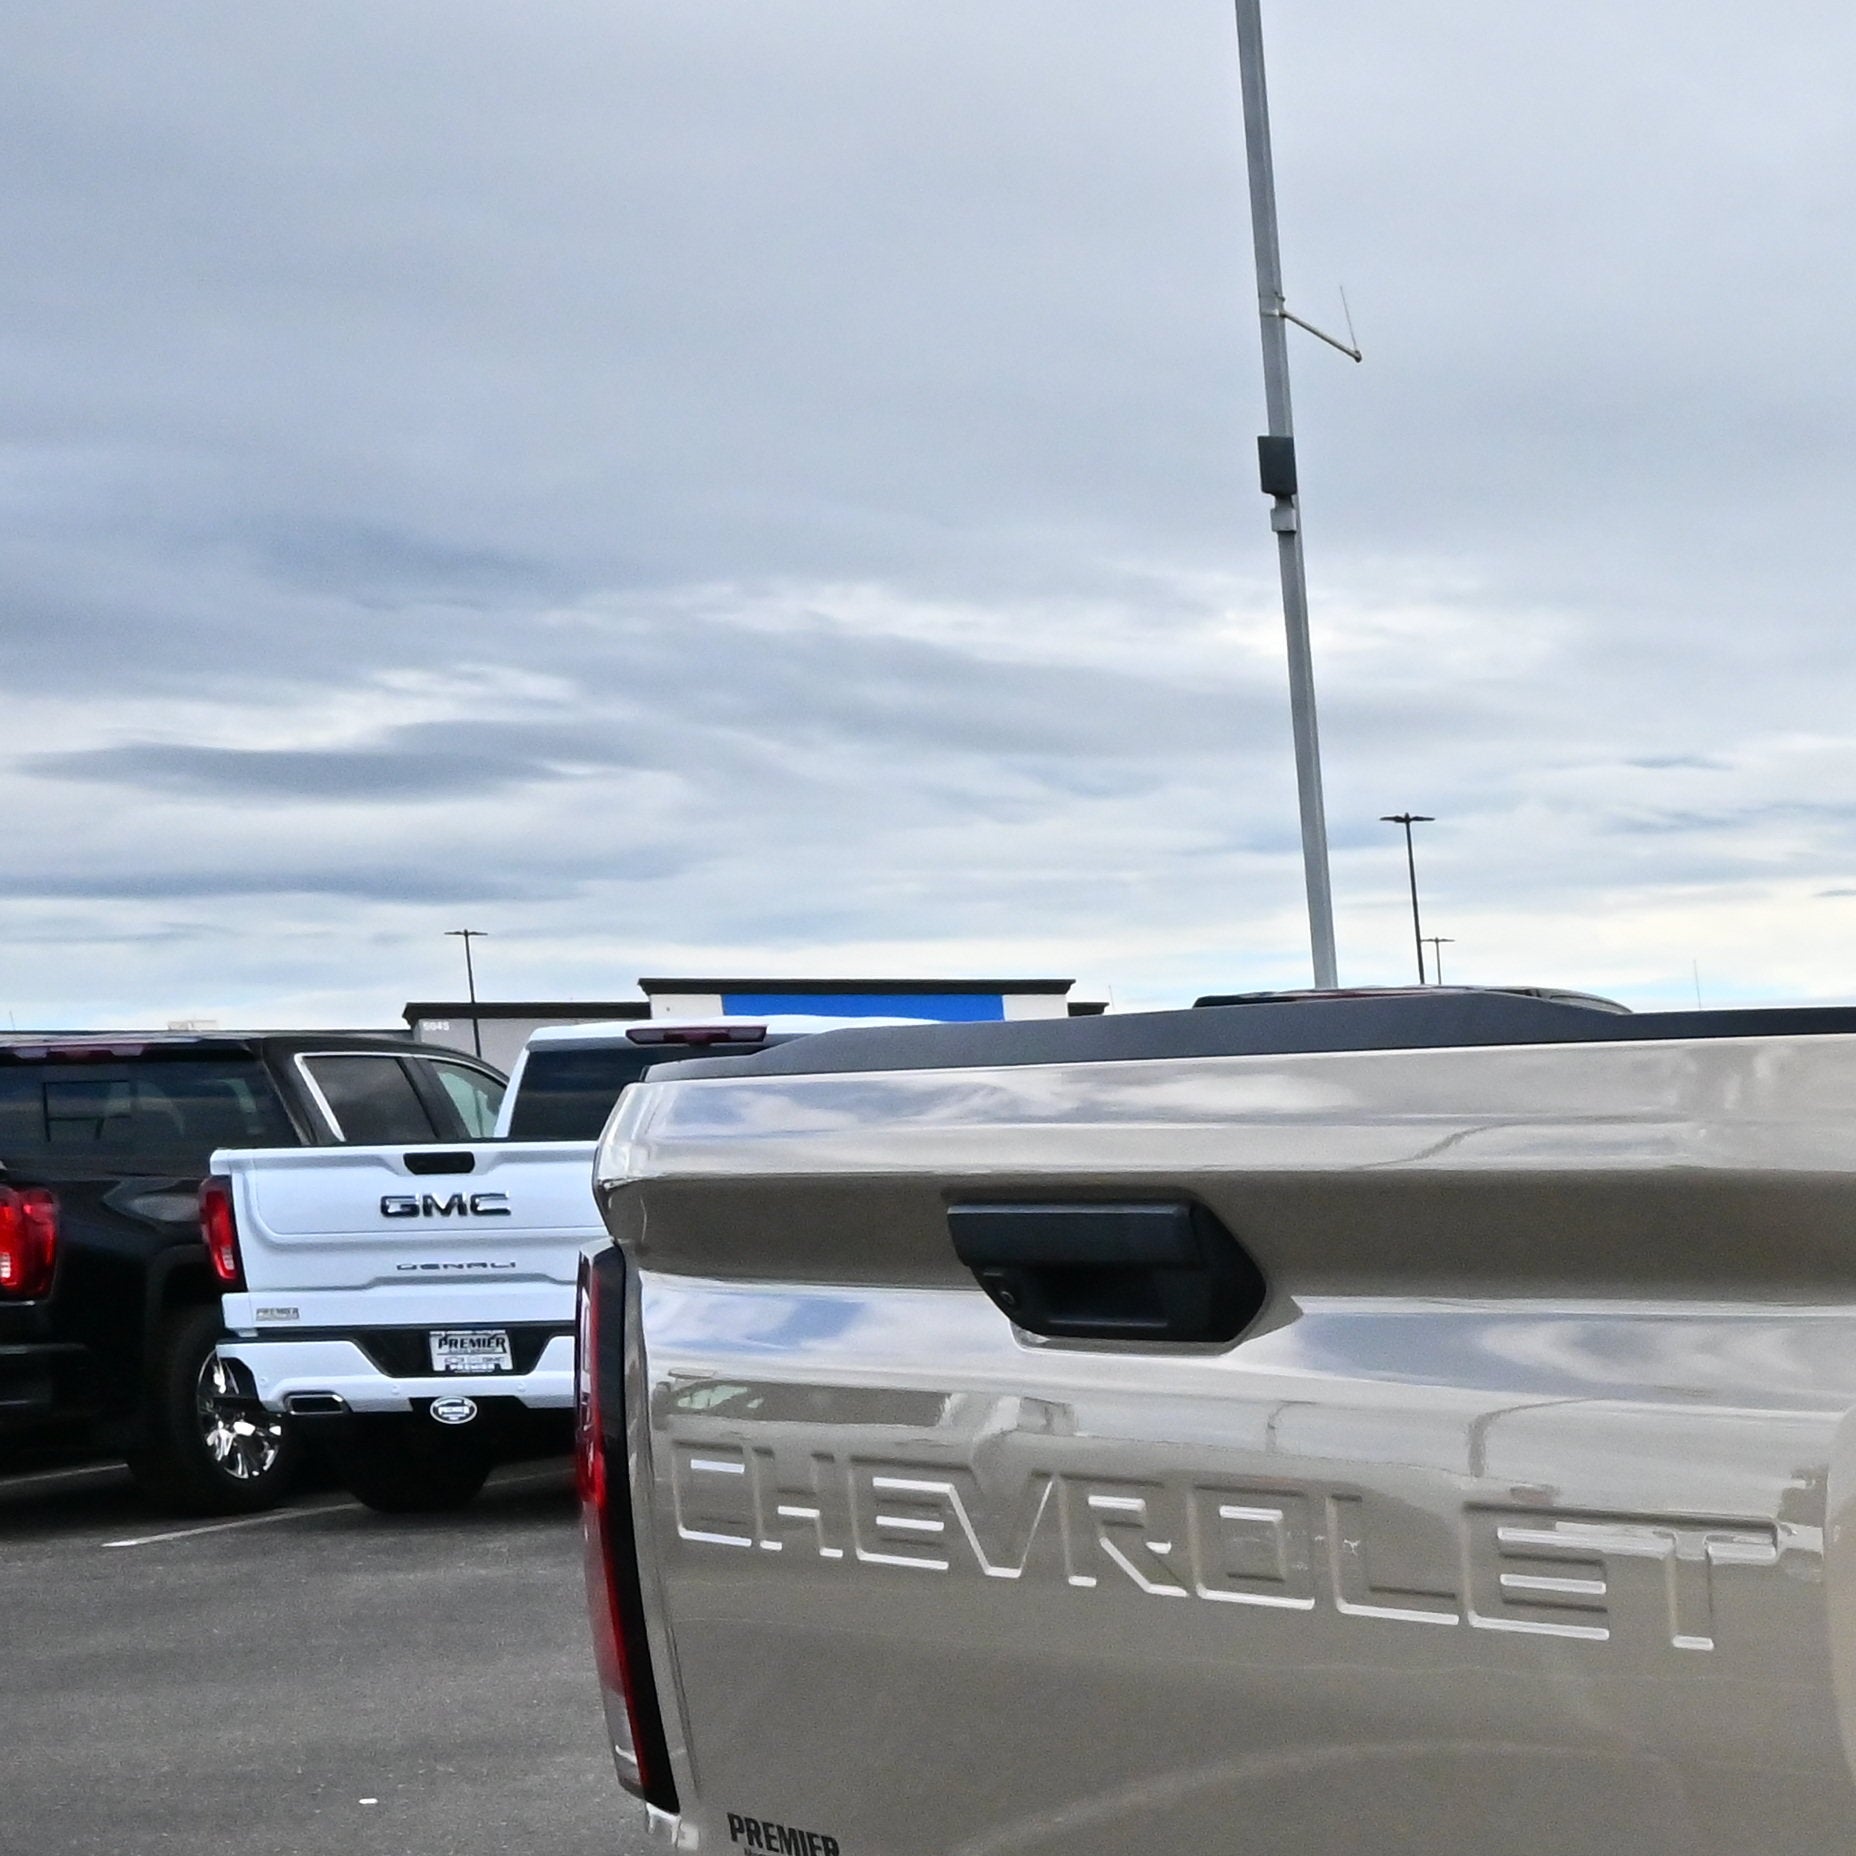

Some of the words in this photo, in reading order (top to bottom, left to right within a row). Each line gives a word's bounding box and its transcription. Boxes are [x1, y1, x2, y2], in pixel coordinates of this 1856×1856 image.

[381, 1193, 511, 1217] GMC
[397, 1262, 516, 1271] DENALI
[438, 1335, 506, 1350] PREMIER
[671, 1437, 1780, 1651] CHEVROLET
